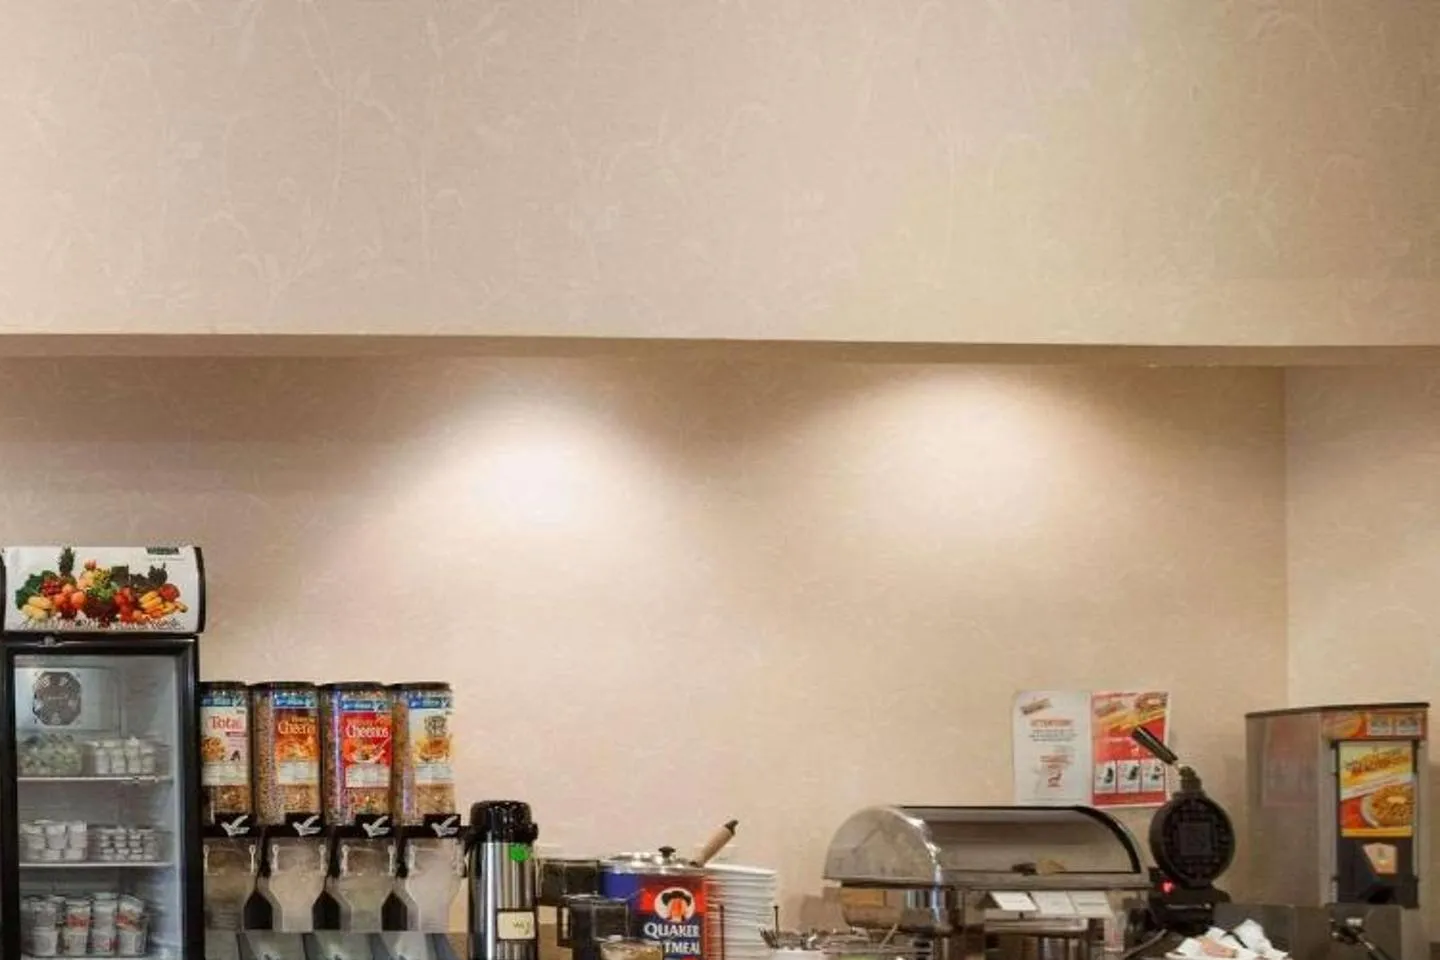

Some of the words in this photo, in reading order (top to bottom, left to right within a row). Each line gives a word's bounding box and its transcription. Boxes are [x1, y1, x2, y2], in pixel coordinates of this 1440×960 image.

[278, 720, 317, 734] Cheerio
[346, 724, 389, 738] Cheerios
[644, 922, 700, 938] QUAKER
[664, 941, 700, 954] TMEAL
